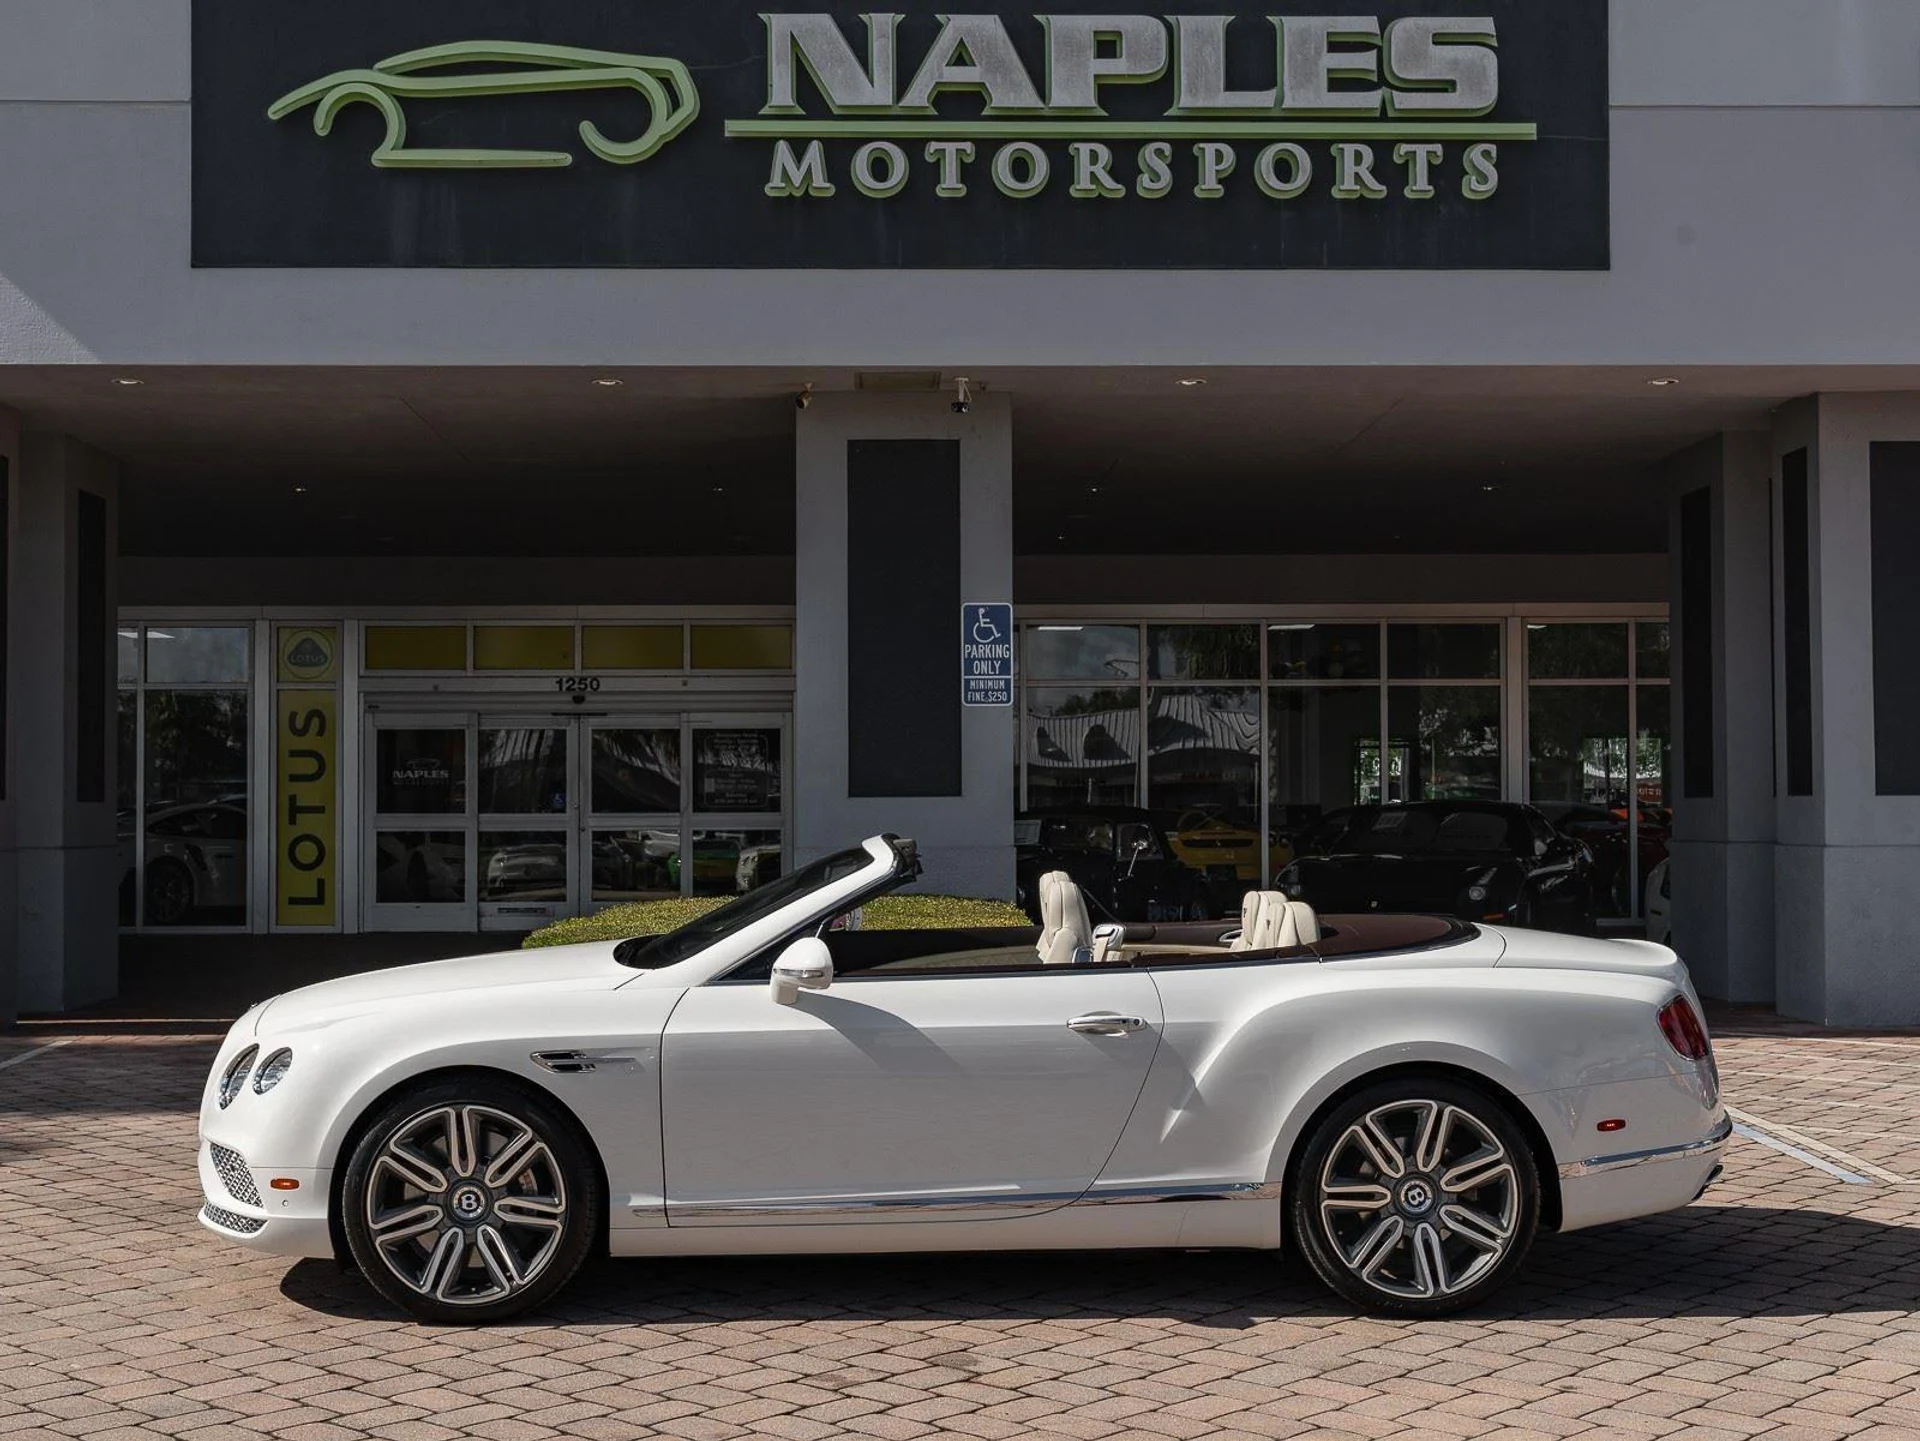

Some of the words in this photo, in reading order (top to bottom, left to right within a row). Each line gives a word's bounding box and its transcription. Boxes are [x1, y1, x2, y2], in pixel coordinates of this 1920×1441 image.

[757, 12, 1499, 117] NAPLES
[764, 139, 1499, 199] MOTORSPORTS
[290, 653, 327, 664] LOTUS
[964, 644, 1010, 659] PARKING
[973, 660, 1001, 675] ONLY
[555, 677, 600, 691] 1250
[969, 679, 1005, 690] MINIMUM
[967, 691, 985, 702] FINE
[987, 691, 1007, 702] $250
[393, 770, 449, 779] NAPLES
[287, 708, 327, 905] LOTUS
[461, 1193, 478, 1210] B
